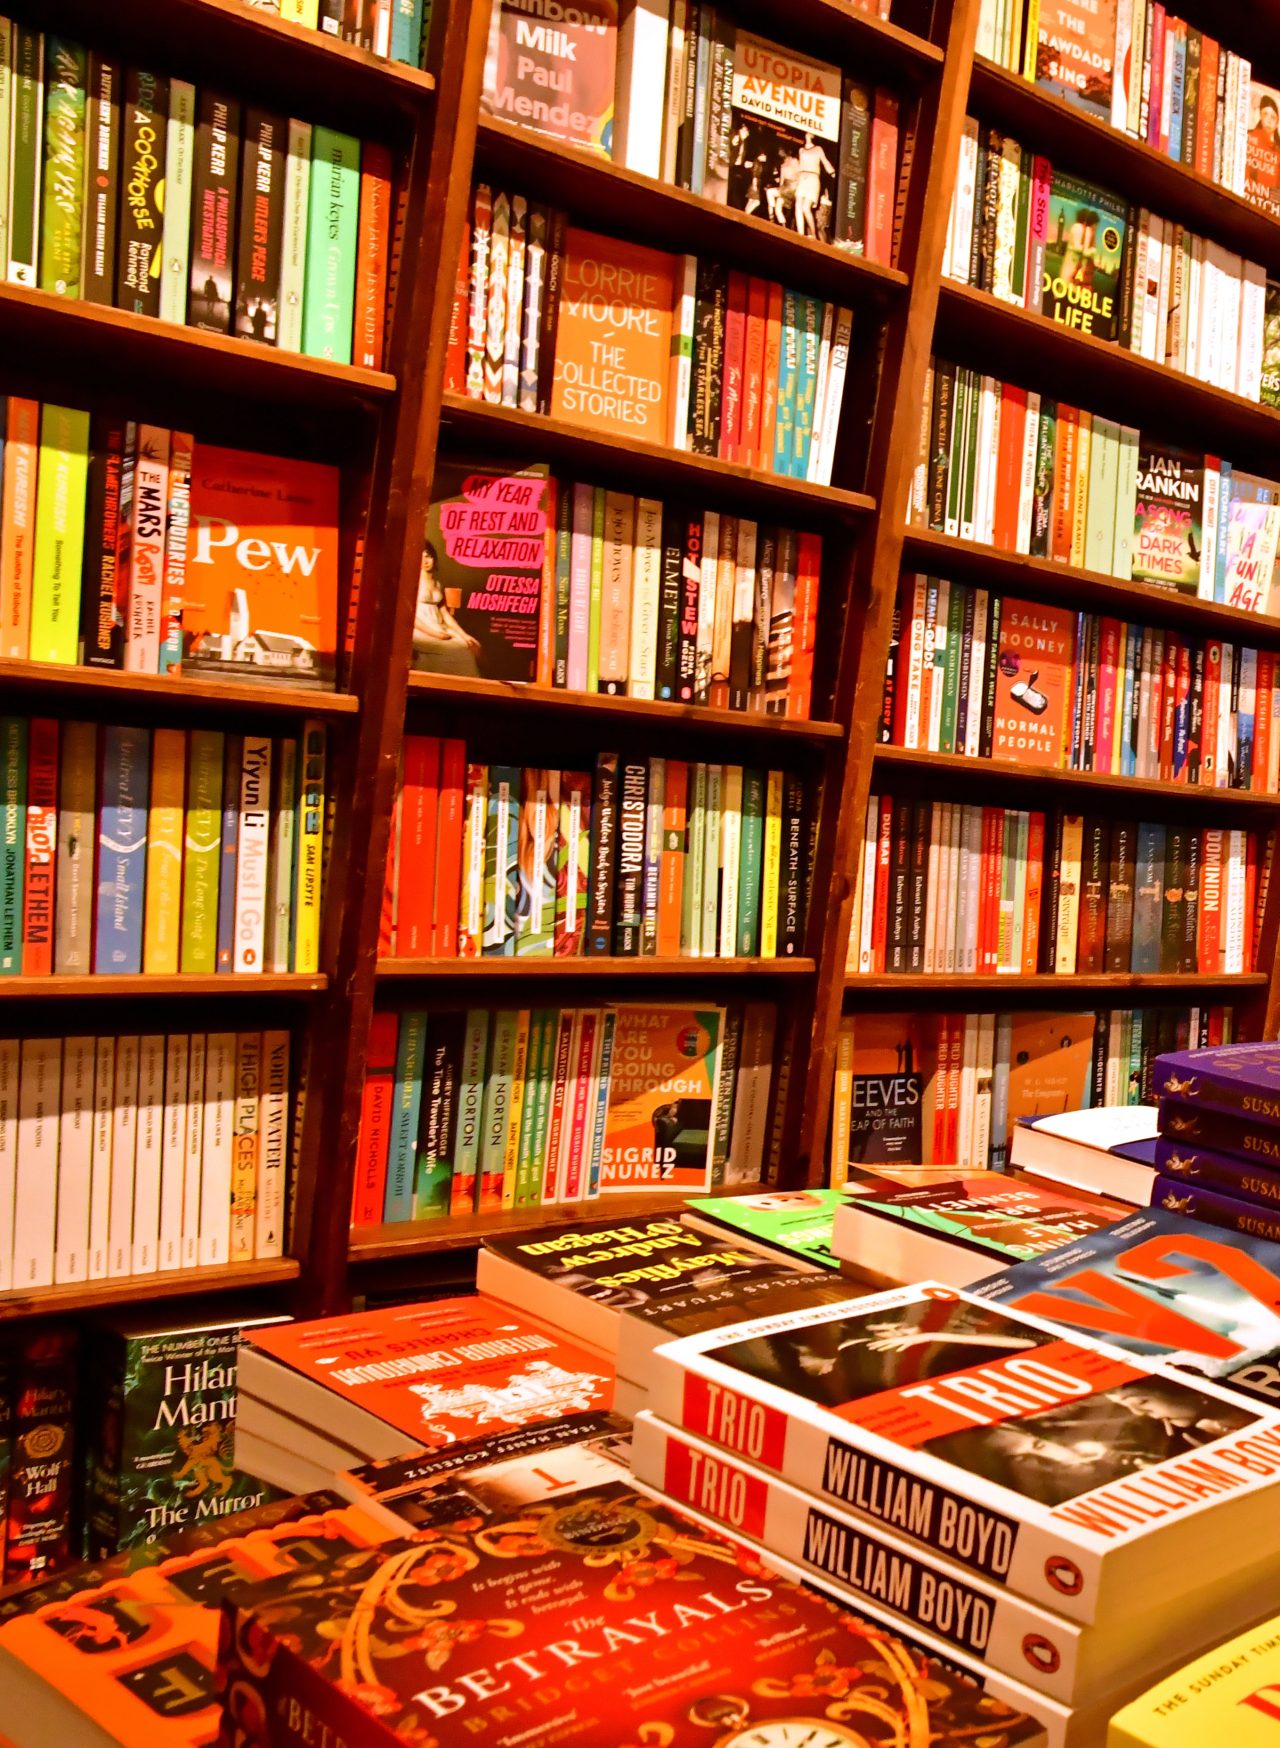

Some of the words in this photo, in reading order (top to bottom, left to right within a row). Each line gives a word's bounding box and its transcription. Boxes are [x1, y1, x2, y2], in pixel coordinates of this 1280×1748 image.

[515, 21, 577, 61] Milk
[744, 48, 824, 94] UTOPIA
[741, 94, 772, 116] DAVID
[773, 106, 824, 132] MITCHELL
[743, 75, 825, 118] AVENUE
[213, 102, 229, 142] PHILIP
[210, 143, 226, 177] KERR
[565, 259, 659, 300] LORRIE
[1042, 274, 1113, 319] DOUBLE
[561, 289, 661, 336] MOORE
[1054, 302, 1094, 334] LIFE
[555, 358, 662, 402] COLLECTED
[562, 388, 647, 424] STORIES
[141, 471, 161, 484] THE
[1149, 454, 1181, 477] IAN
[467, 478, 492, 498] MY
[496, 481, 533, 506] YEAR
[1134, 473, 1199, 502] RANKIN
[138, 486, 162, 538] MARS
[446, 511, 465, 529] OF
[469, 513, 504, 531] REST
[506, 513, 538, 532] AND
[191, 514, 322, 576] Pew
[453, 537, 539, 562] RELAXATION
[467, 592, 539, 614] MOSHFEGH
[486, 575, 539, 595] OTTESSA
[1011, 613, 1058, 633] SALLY
[1001, 631, 1065, 655] ROONEY
[996, 717, 1056, 736] NORMAL
[998, 735, 1051, 753] PEOPLE
[242, 746, 268, 805] Yiyun
[244, 812, 264, 827] Li
[620, 766, 646, 873] CHRISTODORA
[1203, 832, 1223, 911] DOMINION
[240, 1054, 258, 1101] HIGH
[237, 1104, 256, 1171] PLACES
[602, 1147, 677, 1163] SIGRID
[602, 1163, 675, 1180] NUNEZ
[521, 1221, 685, 1258] O'Hagan
[558, 1232, 702, 1270] Andrew
[595, 1251, 763, 1289] Mayflies
[456, 1334, 558, 1362] INTERIOR
[901, 1359, 1093, 1423] TRIO
[706, 1383, 765, 1459] TRIO
[26, 1465, 60, 1481] Wolf
[26, 1477, 57, 1497] Hall
[687, 1451, 746, 1525] TRIO
[144, 1505, 190, 1528] The
[194, 1492, 264, 1520] Mirror
[828, 1445, 933, 1539] WILLIAM
[939, 1510, 1014, 1574] BOYD
[1051, 1457, 1241, 1537] WILLIAM
[807, 1514, 913, 1608] WILLIAM
[919, 1581, 991, 1649] BOYD
[411, 1579, 775, 1717] BETRAYALS
[1153, 1698, 1191, 1717] THE
[1195, 1654, 1249, 1694] SUNDAY
